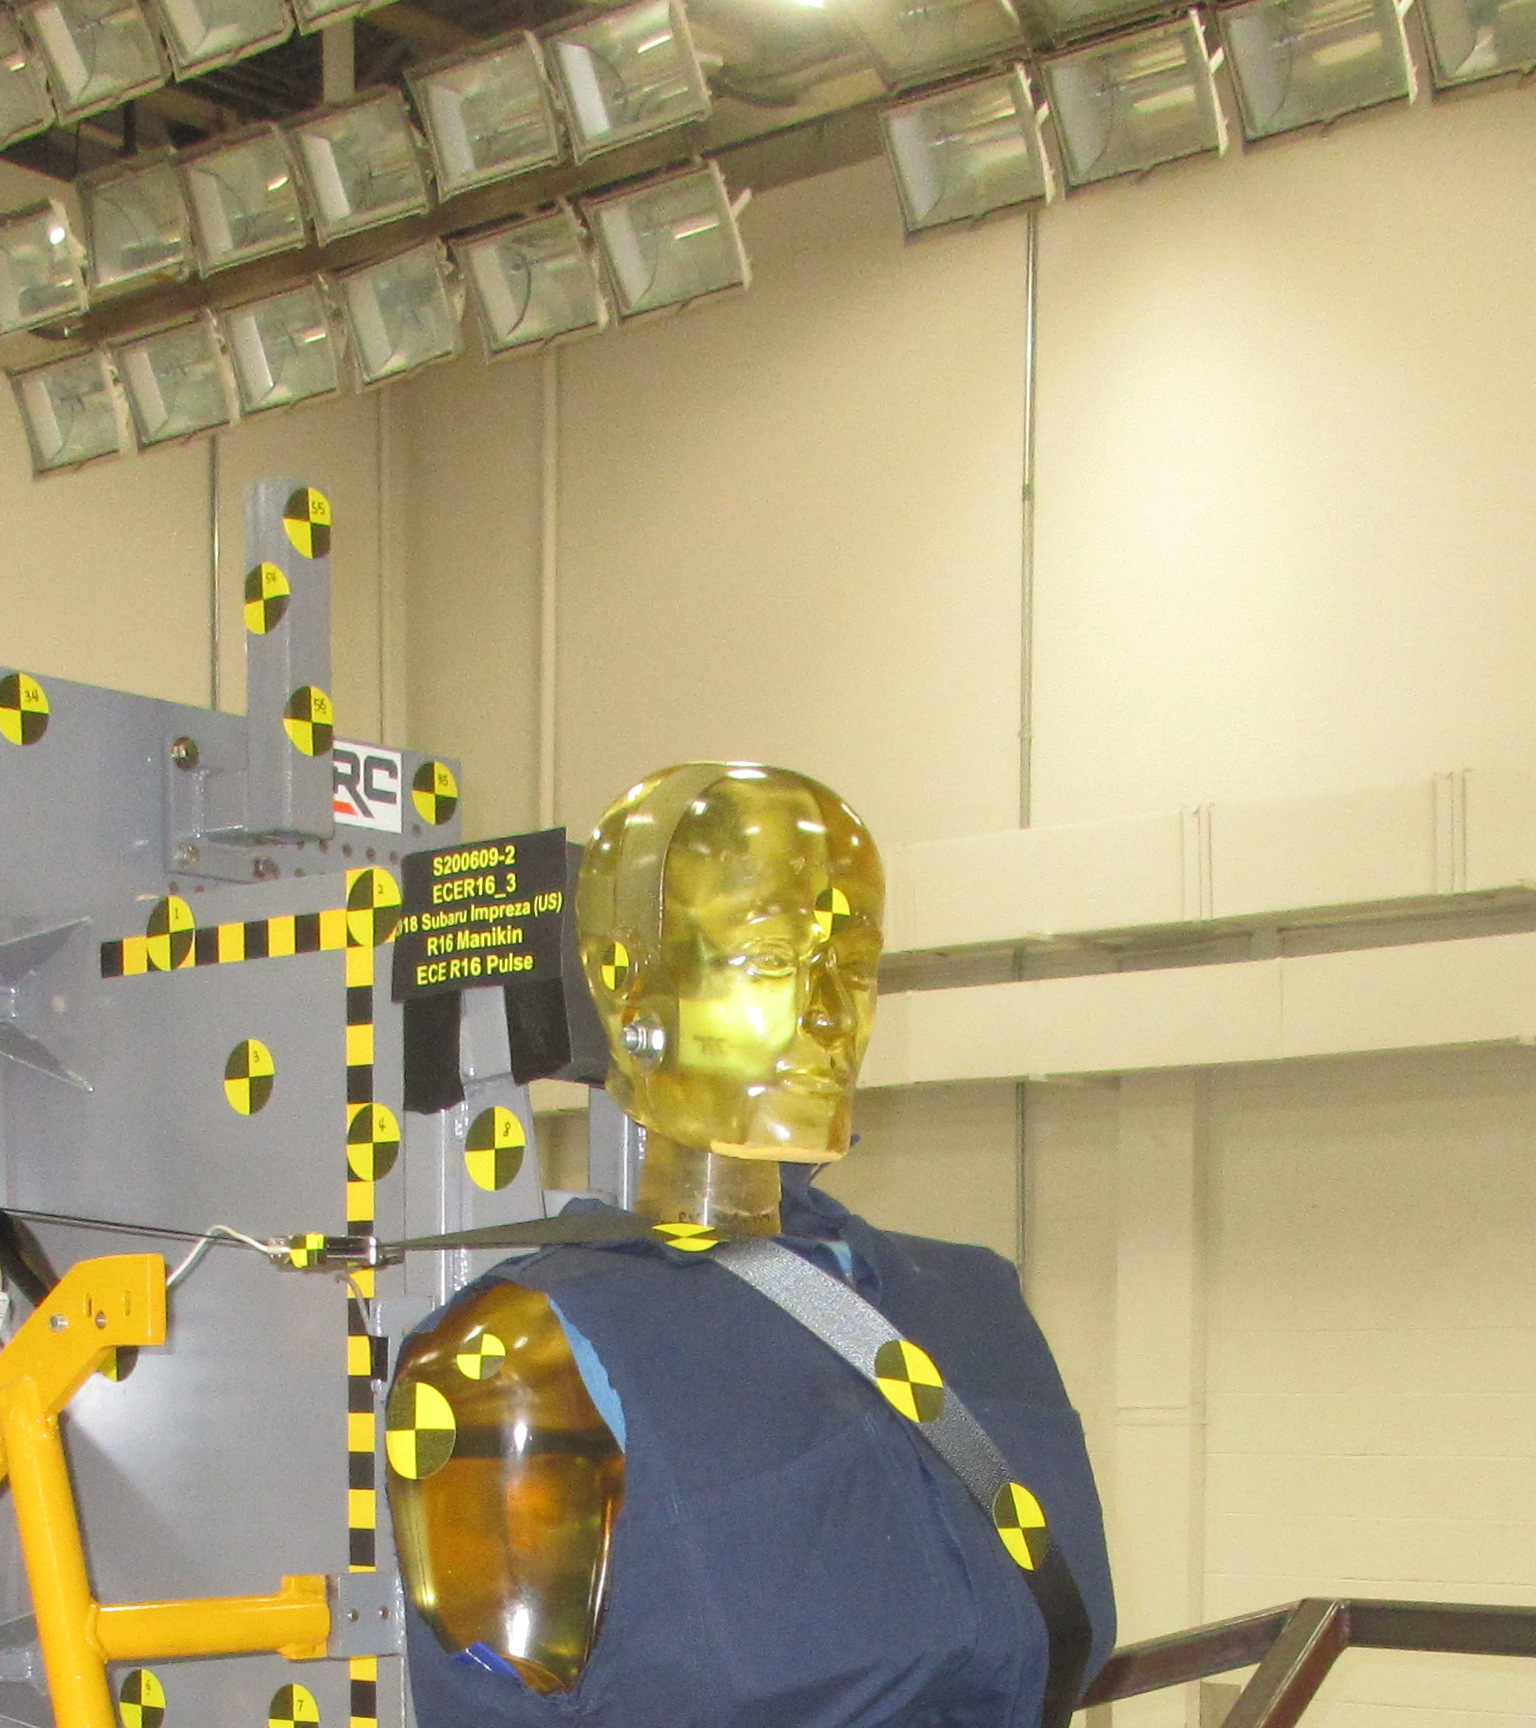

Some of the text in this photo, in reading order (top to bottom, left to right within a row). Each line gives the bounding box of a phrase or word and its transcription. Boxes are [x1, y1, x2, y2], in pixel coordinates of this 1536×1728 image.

[311, 501, 326, 515] 55
[25, 688, 39, 703] 34
[333, 749, 398, 819] RC
[433, 845, 516, 877] S200609-2
[433, 873, 517, 904] ECER16_3
[422, 908, 467, 931] Subaru
[470, 899, 531, 924] Impreza
[534, 892, 563, 917] (US)
[427, 926, 523, 956] R16 Manikin
[416, 952, 533, 985] ECE R16 Pulse
